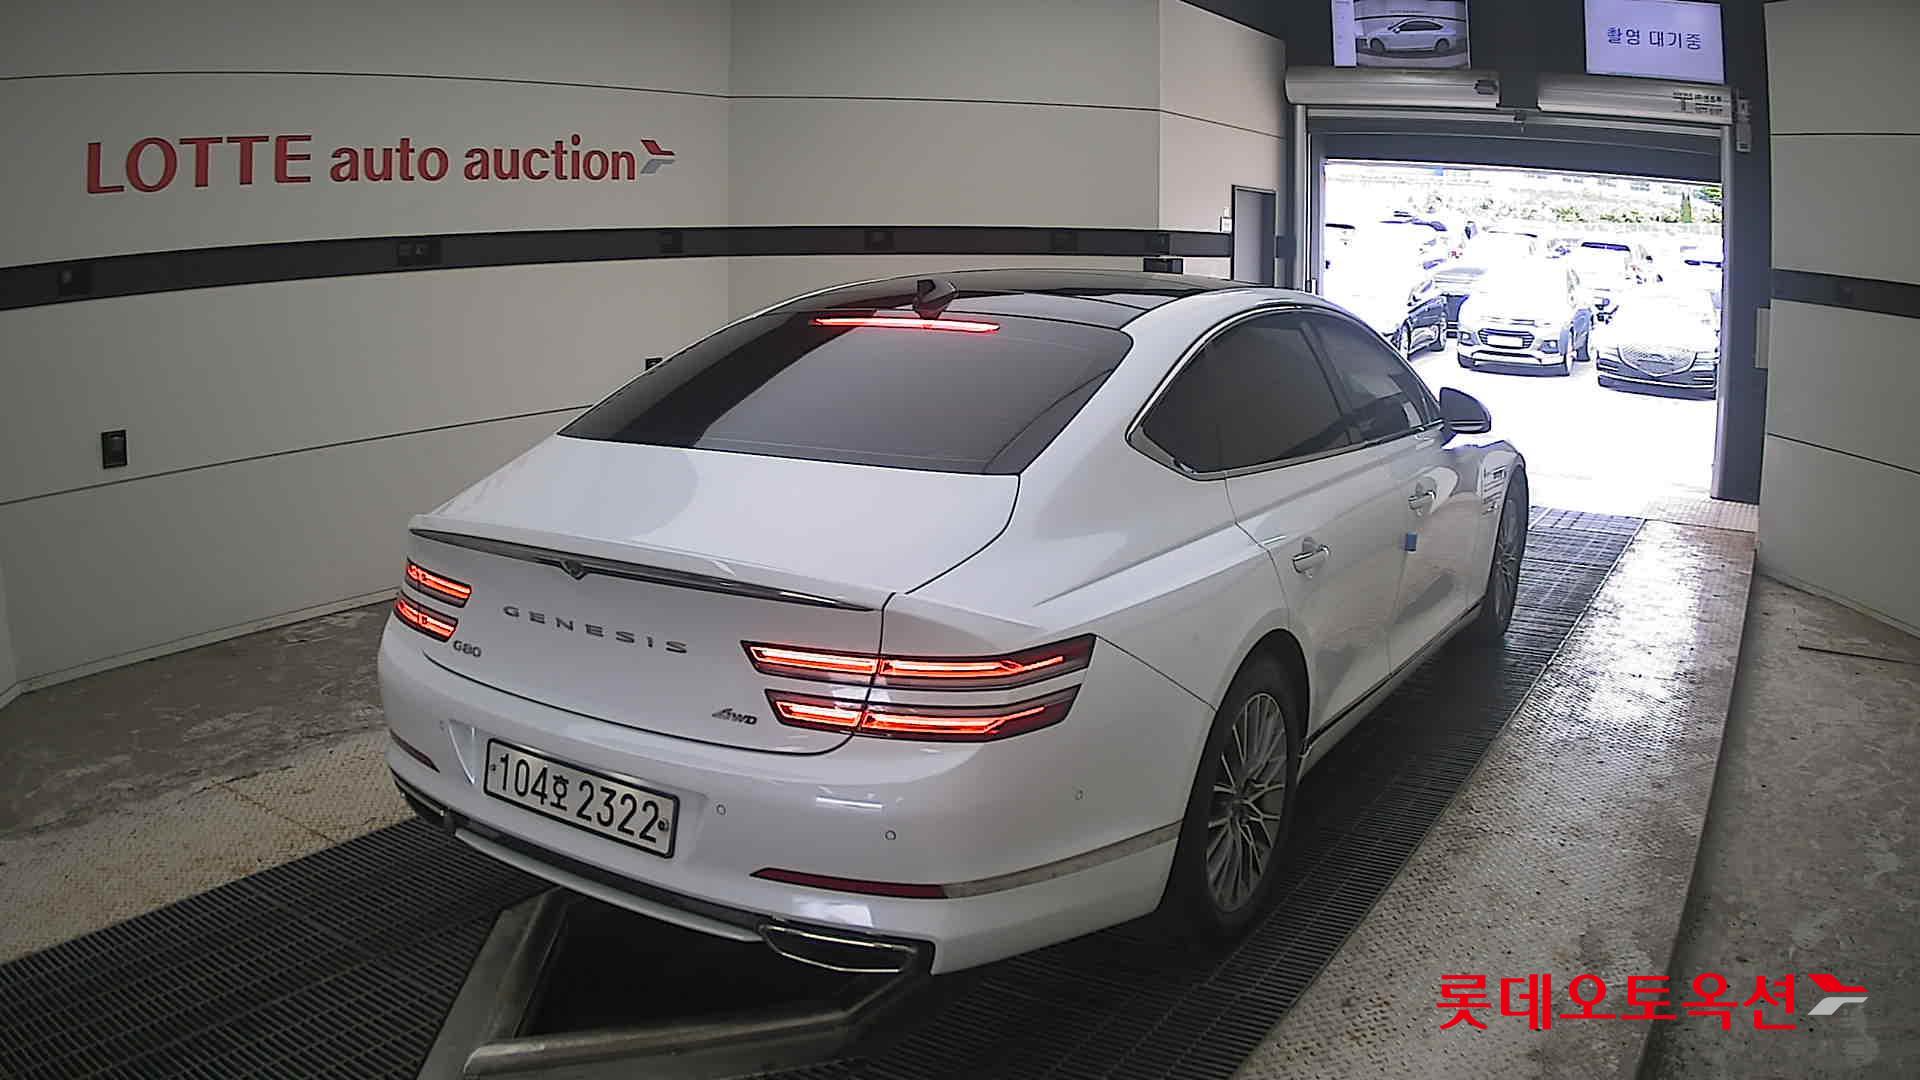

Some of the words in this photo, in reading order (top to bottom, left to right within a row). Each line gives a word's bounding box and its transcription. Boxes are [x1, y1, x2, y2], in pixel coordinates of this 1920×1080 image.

[1607, 27, 1641, 45] 촬영
[1649, 31, 1702, 50] 대기중
[87, 134, 312, 194] LOTTE
[329, 137, 449, 182] auto
[463, 133, 636, 181] auction
[453, 640, 482, 657] G80
[503, 605, 688, 654] GENESIS
[500, 753, 569, 811] 104호
[576, 780, 660, 843] 2322
